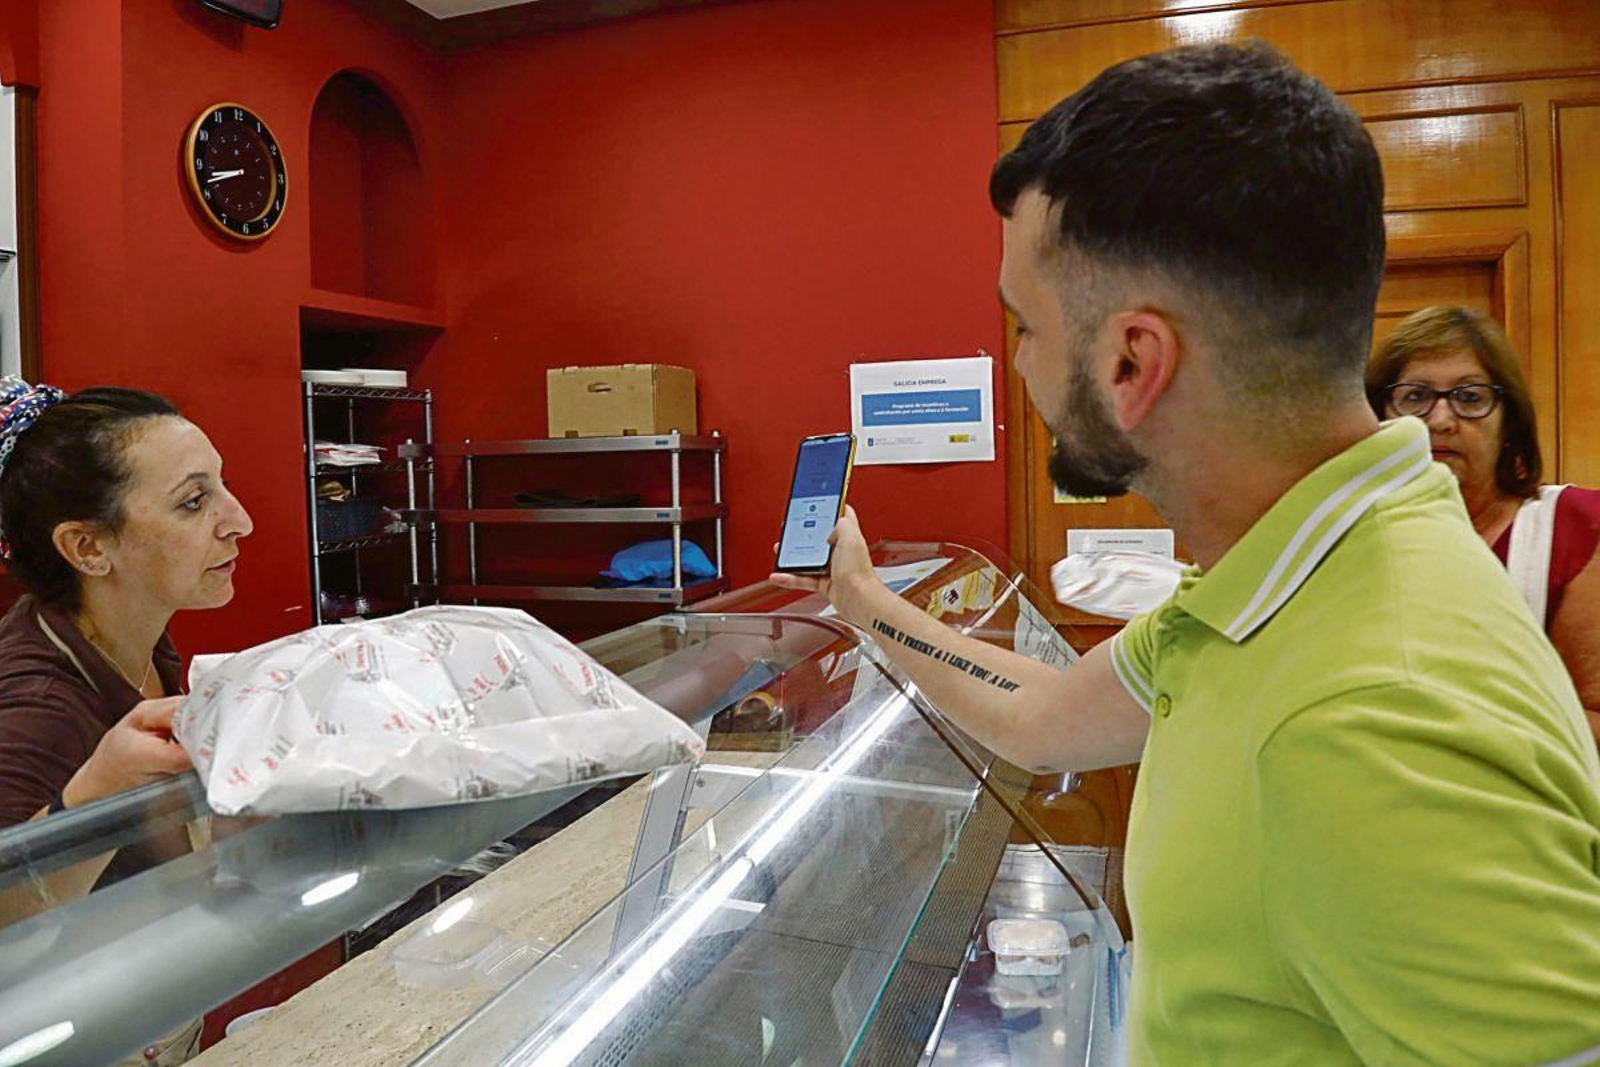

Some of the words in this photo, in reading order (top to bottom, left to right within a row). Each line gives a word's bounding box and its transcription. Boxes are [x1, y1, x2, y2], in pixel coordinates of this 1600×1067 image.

[214, 111, 222, 123] 11
[234, 109, 243, 121] 12
[257, 122, 261, 133] 1
[199, 129, 209, 141] 10
[271, 144, 277, 156] 2
[196, 158, 203, 170] 9
[278, 173, 284, 185] 3
[275, 200, 280, 211] 4
[221, 213, 227, 225] 7
[262, 218, 269, 229] 5
[243, 223, 249, 235] 6
[872, 618, 878, 629] I
[897, 631, 905, 642] U
[934, 648, 943, 660] &
[942, 651, 949, 662] I
[948, 654, 972, 671] LIKE
[970, 664, 992, 681] YOU
[988, 675, 999, 685] A
[998, 678, 1021, 693] LOT
